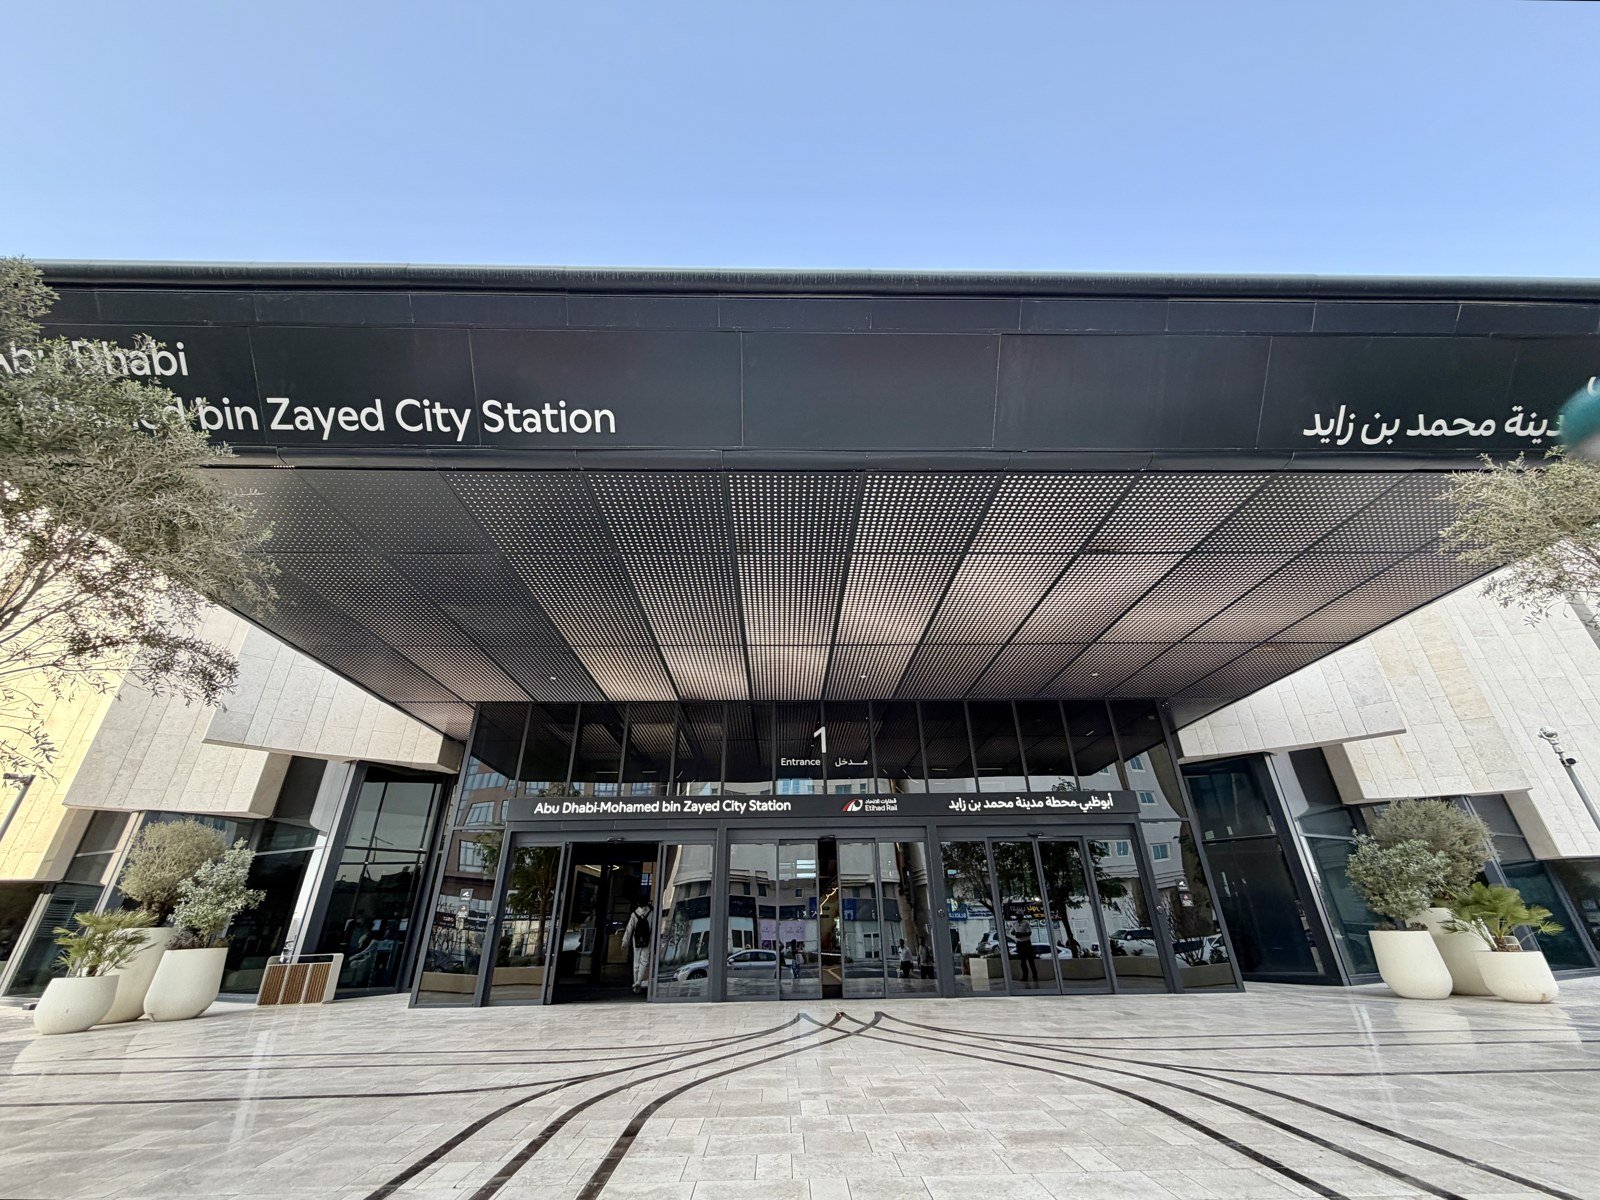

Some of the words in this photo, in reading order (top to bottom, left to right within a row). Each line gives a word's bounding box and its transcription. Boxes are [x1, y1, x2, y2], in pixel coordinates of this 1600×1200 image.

[197, 396, 258, 431] bin
[266, 397, 385, 441] Zayed
[395, 398, 472, 442] City
[482, 399, 616, 434] Station
[1302, 404, 1355, 445] زايد
[1406, 413, 1496, 437] محمد
[1504, 405, 1565, 444] دينة
[1361, 412, 1401, 445] بن
[813, 726, 827, 754] 1
[780, 757, 821, 766] Entrance
[533, 801, 560, 814] Abu
[562, 800, 660, 813] Dhabi-Mohamed
[662, 800, 681, 812] bin
[683, 799, 720, 815] Zayed
[722, 799, 747, 814] City
[748, 799, 792, 811] Station
[864, 804, 886, 812] Etihad
[886, 803, 898, 811] Rail
[948, 797, 967, 812] زايد
[968, 799, 981, 812] بن
[983, 799, 1014, 809] محمد
[1015, 796, 1044, 811] مدينة
